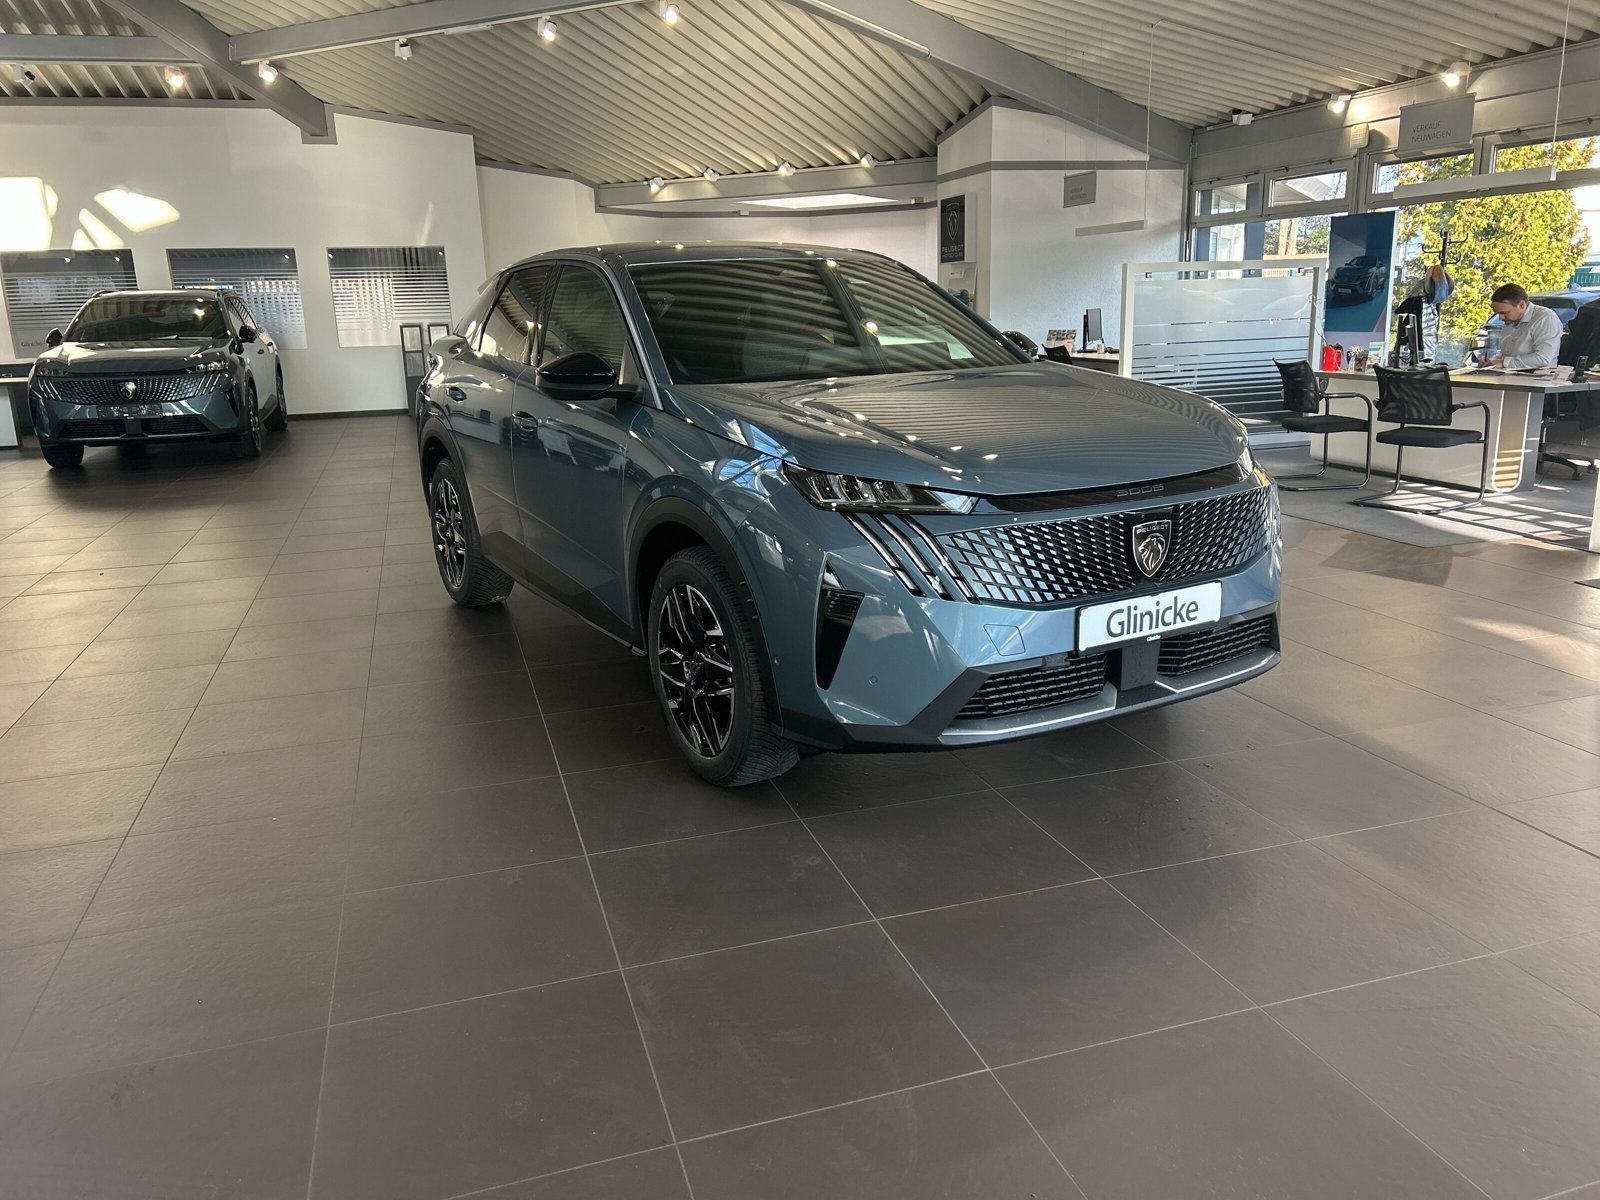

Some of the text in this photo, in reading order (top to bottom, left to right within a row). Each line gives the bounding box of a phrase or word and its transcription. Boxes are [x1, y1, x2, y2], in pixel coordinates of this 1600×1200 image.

[1412, 120, 1440, 133] VERKAUF
[1411, 129, 1452, 142] NEUWAGEN
[941, 244, 964, 253] PEUGEOT
[1136, 524, 1169, 535] PEUGEOT
[1106, 596, 1199, 638] Glinicke
